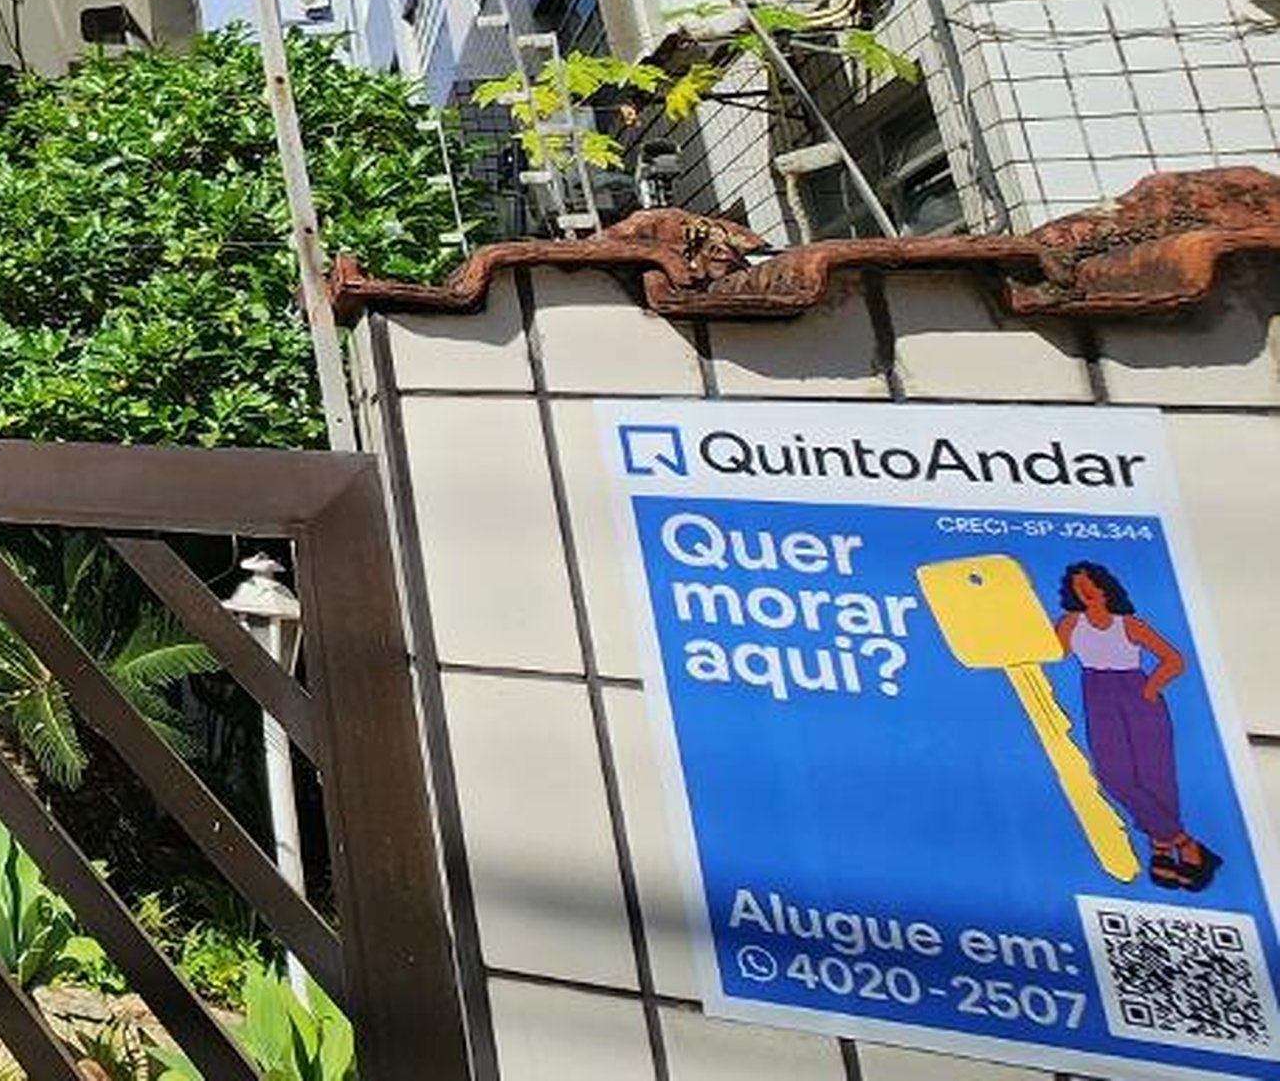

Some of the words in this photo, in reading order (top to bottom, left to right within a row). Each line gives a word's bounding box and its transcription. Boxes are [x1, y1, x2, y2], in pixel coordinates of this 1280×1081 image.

[699, 429, 1145, 488] QuintoAndar
[660, 512, 863, 575] Quer
[671, 578, 917, 637] morar
[683, 638, 908, 700] aqui?
[728, 888, 943, 956] Alugue
[958, 928, 1081, 976] em:
